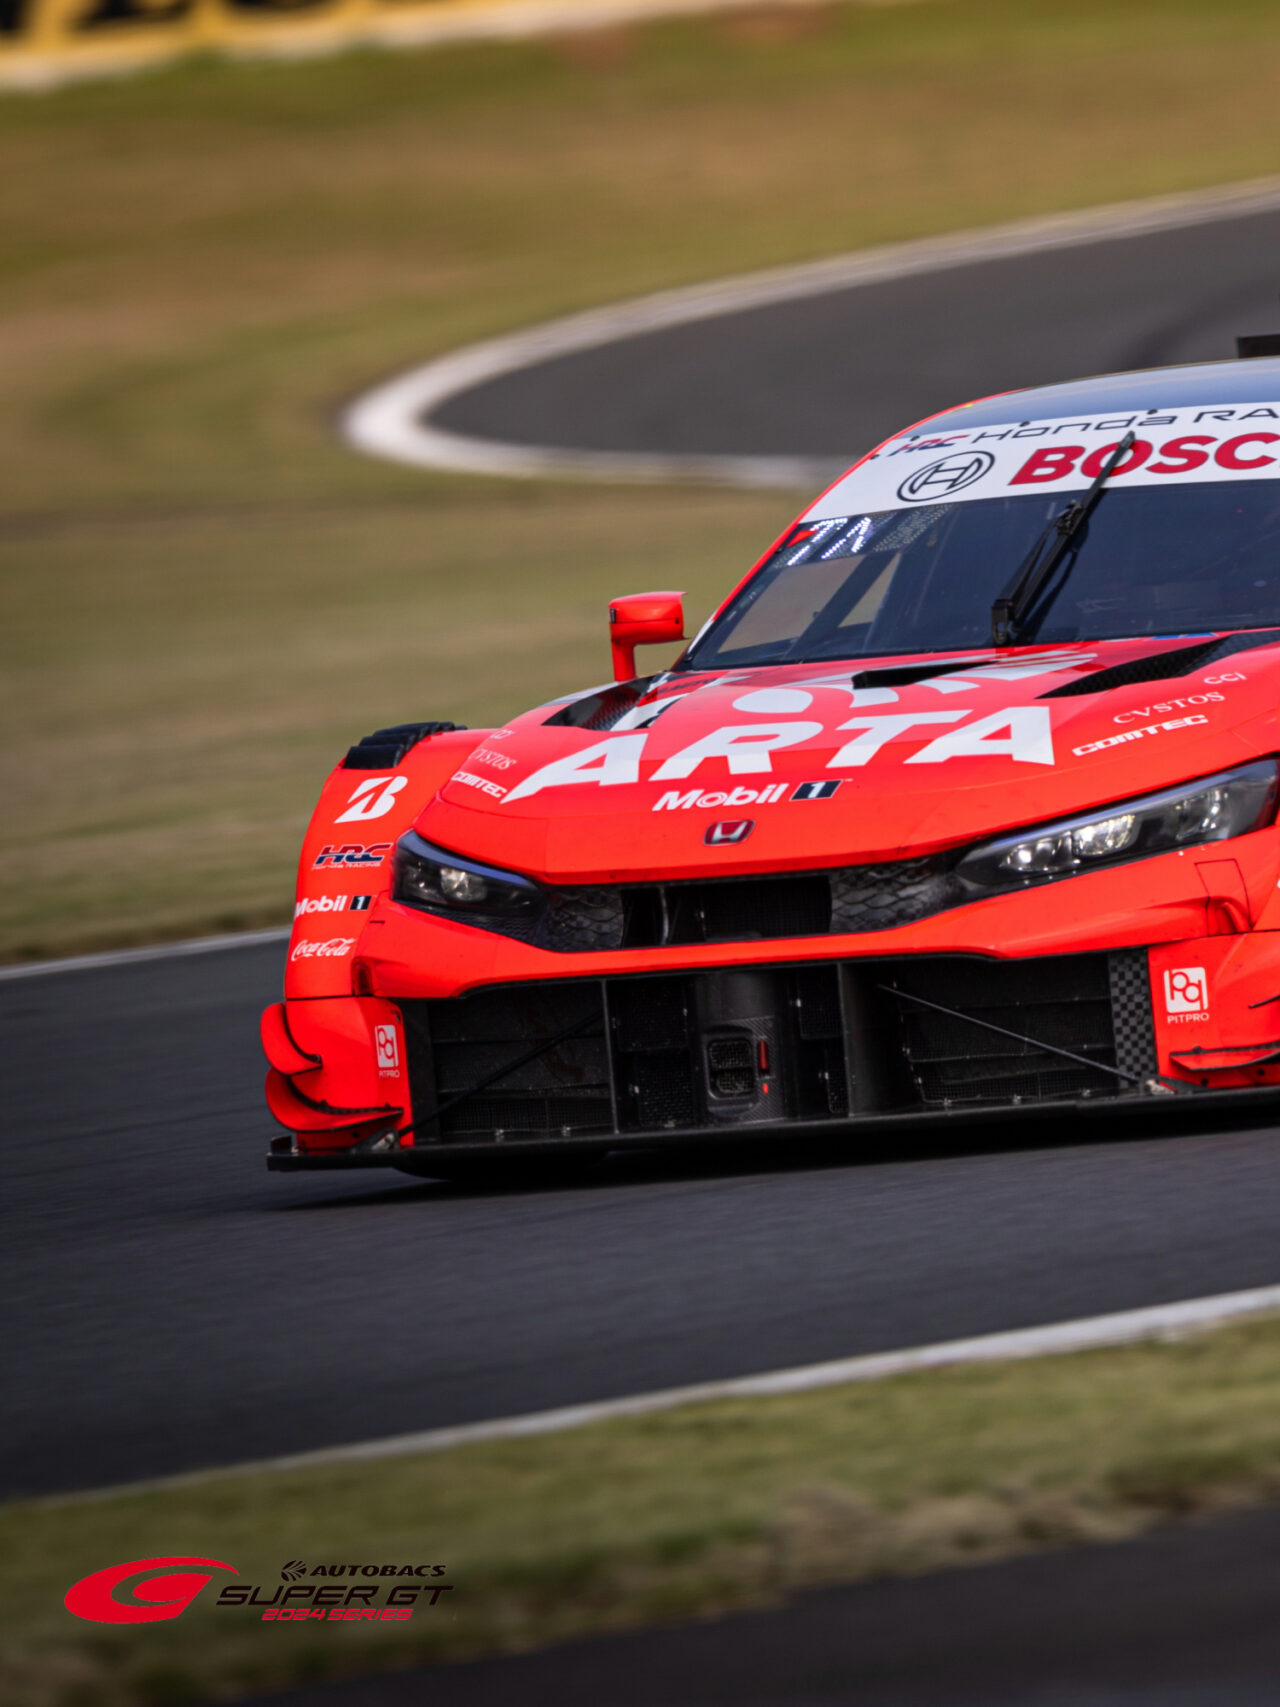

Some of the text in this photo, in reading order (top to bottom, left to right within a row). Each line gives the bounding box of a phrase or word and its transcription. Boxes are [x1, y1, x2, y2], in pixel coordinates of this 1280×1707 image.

[1113, 691, 1225, 724] CVSTOS
[1072, 714, 1209, 756] COMTEC
[498, 706, 1056, 804] ARTA
[450, 770, 508, 798] COMTEC
[651, 783, 789, 812] Mobil
[312, 842, 394, 866] HRC
[294, 895, 348, 918] Mobil
[1167, 1012, 1210, 1024] PITPRO
